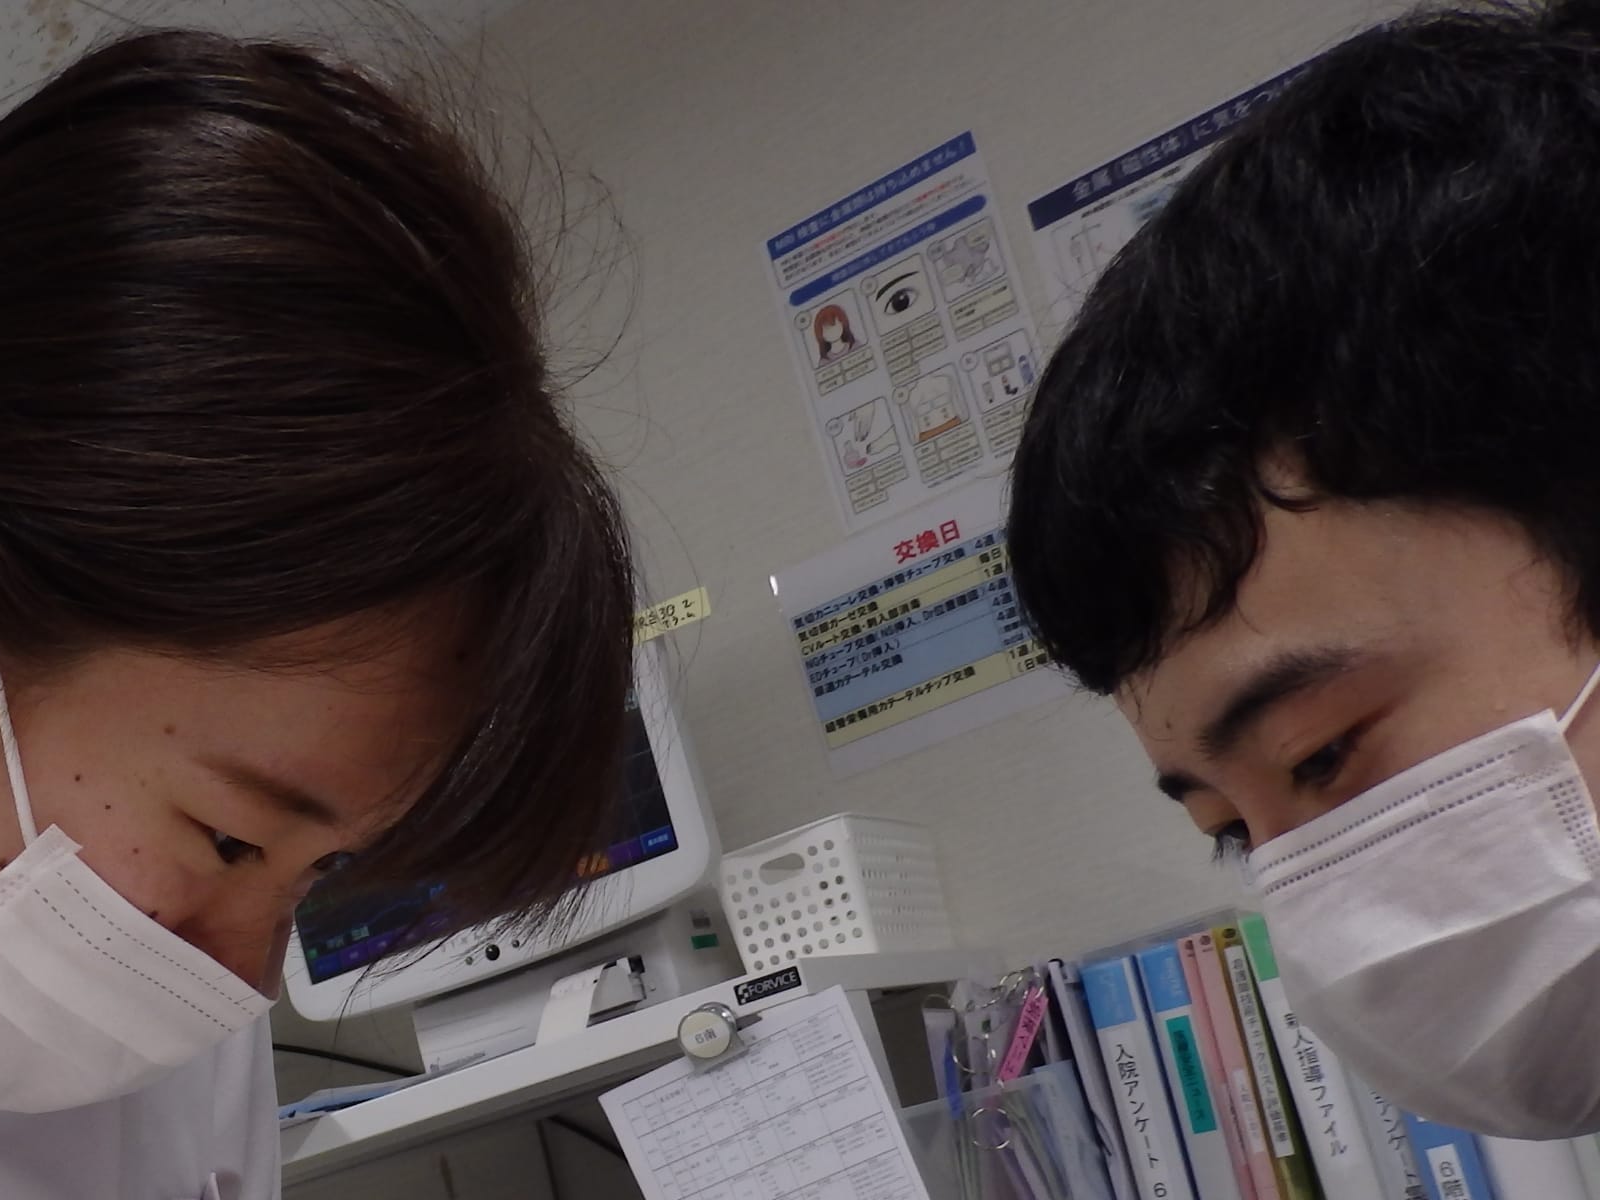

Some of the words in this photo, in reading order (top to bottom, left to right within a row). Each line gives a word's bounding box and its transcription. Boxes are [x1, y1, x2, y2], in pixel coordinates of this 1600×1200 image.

[892, 520, 961, 564] 交換日
[746, 970, 799, 998] FORVICE
[1111, 1041, 1162, 1171] 入院アンケート
